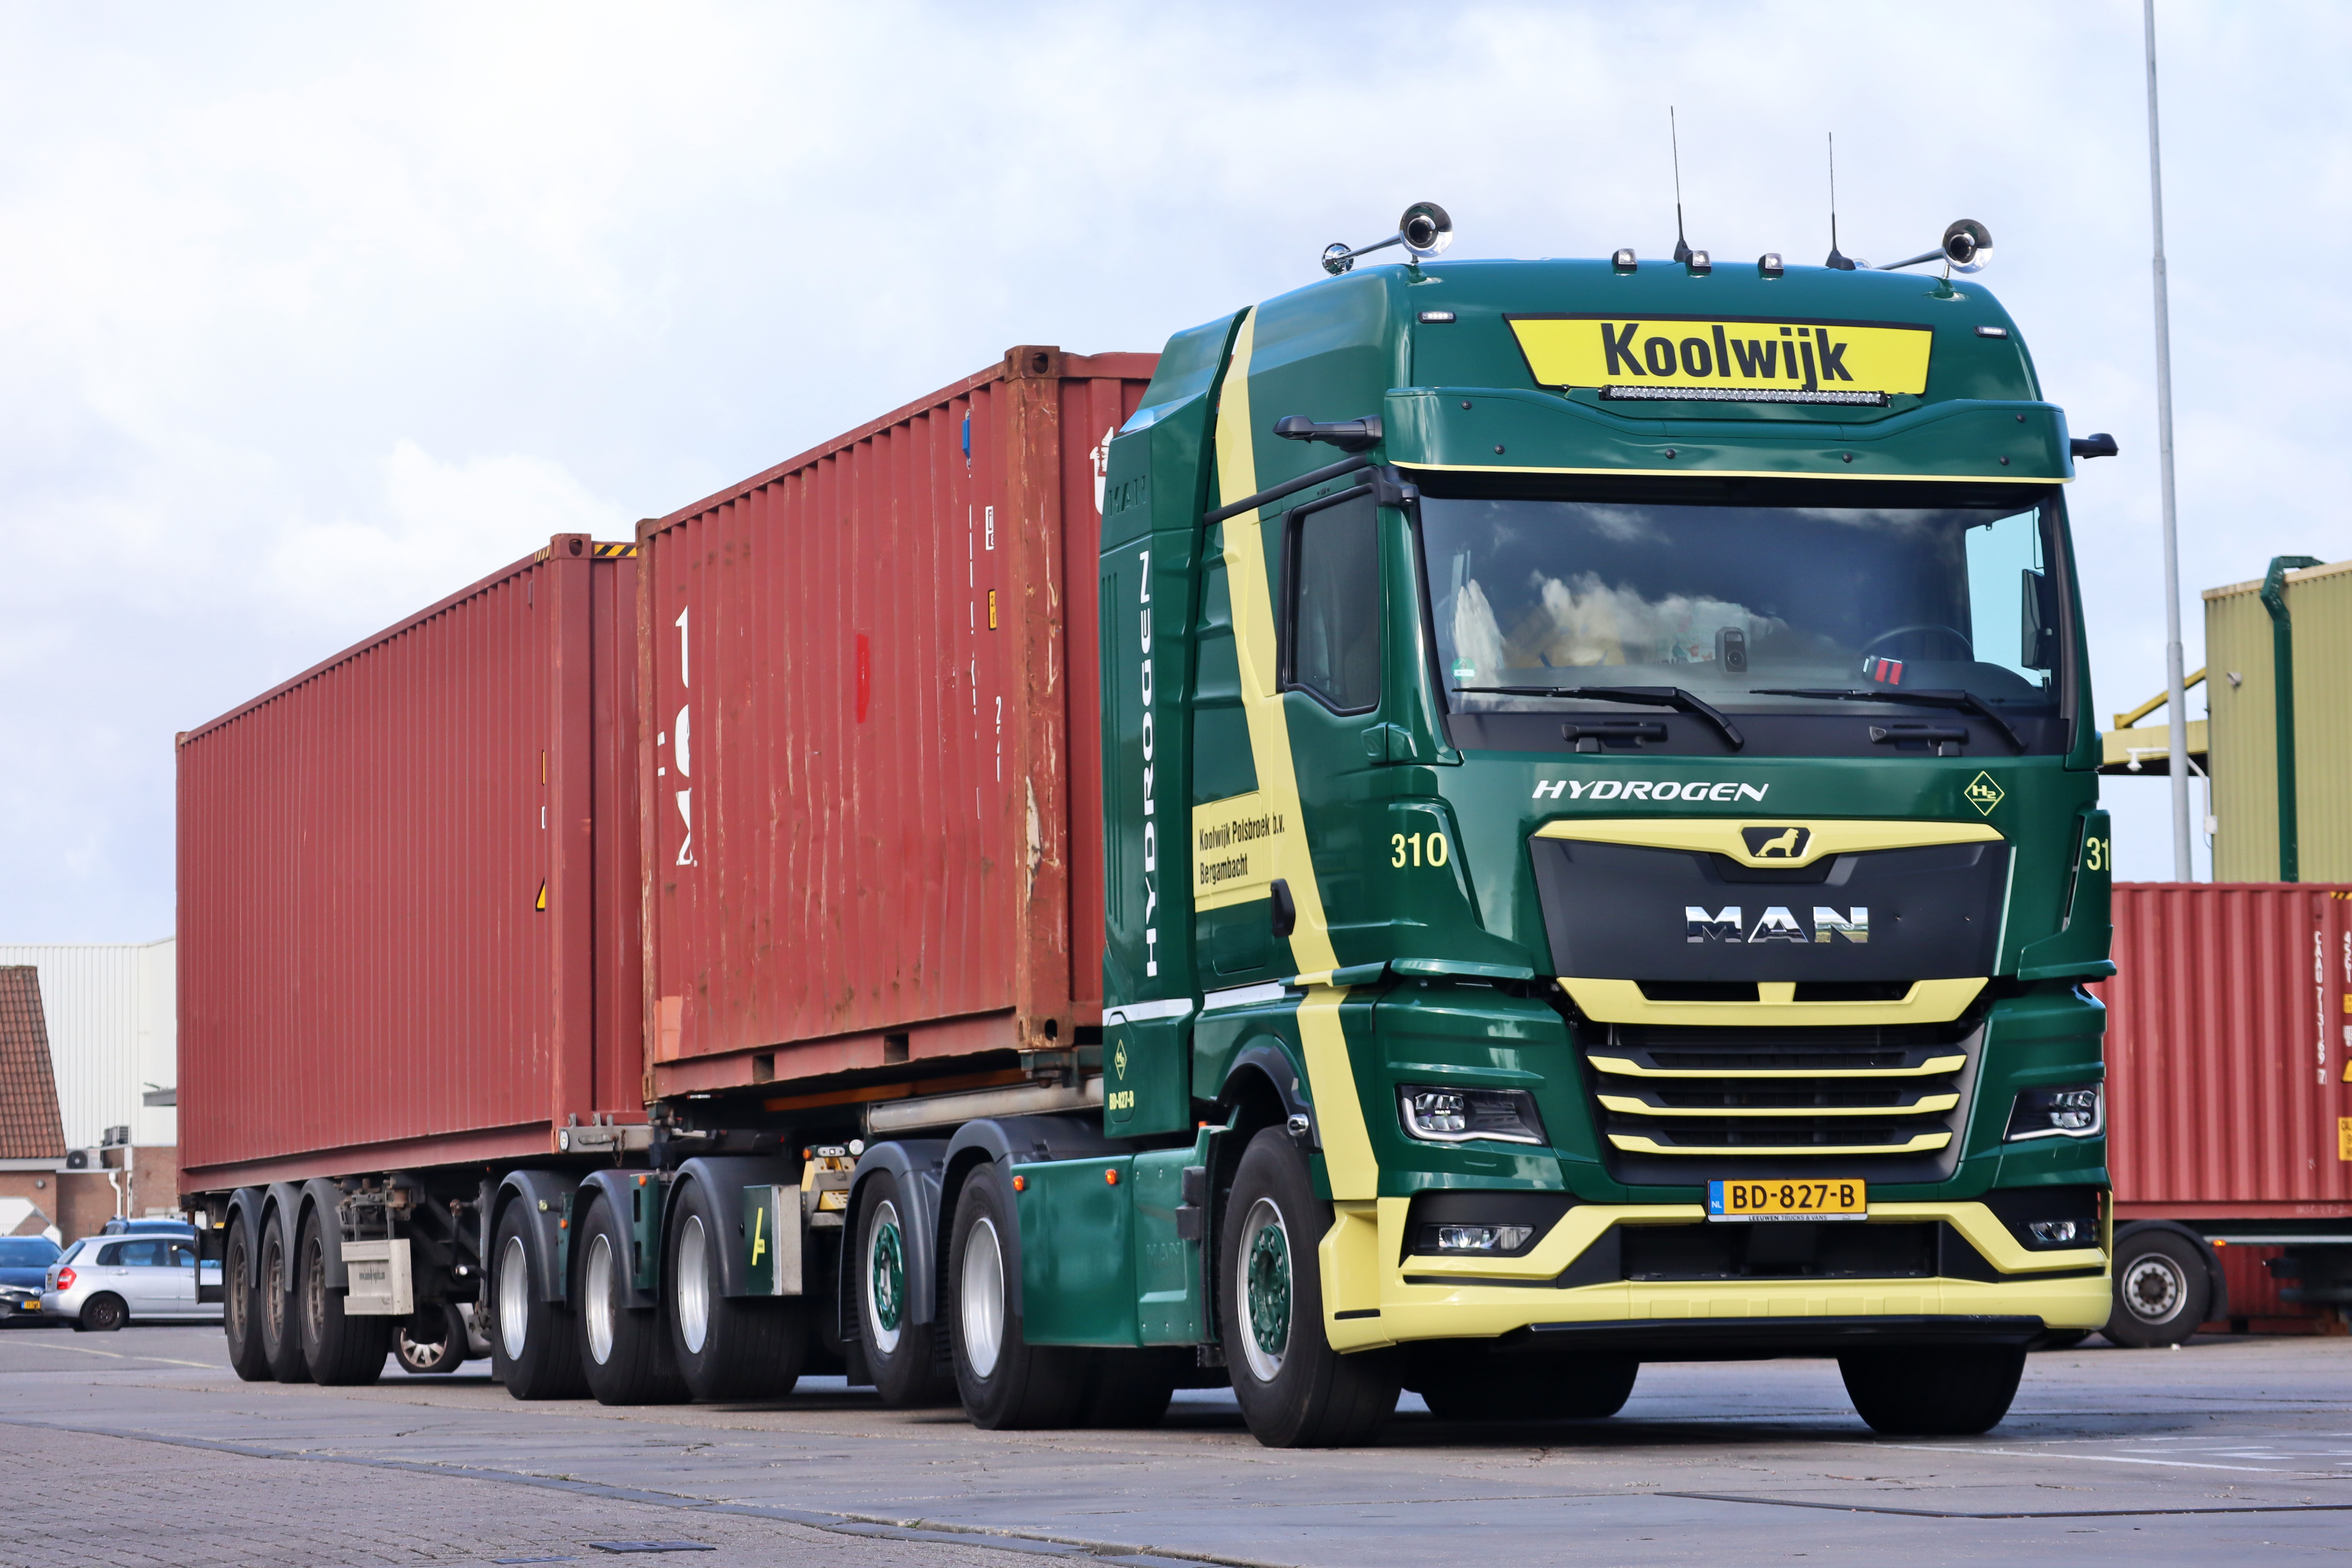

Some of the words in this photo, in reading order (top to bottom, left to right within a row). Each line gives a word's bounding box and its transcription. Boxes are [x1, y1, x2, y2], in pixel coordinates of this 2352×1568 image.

[1601, 323, 1854, 391] Koolwijk
[1108, 475, 1146, 517] MAN
[1139, 550, 1158, 977] HYDROGEN
[1532, 780, 1769, 801] HYDROGEN
[1200, 822, 1230, 851] Koolwijk
[1232, 813, 1270, 844] Polsbroek
[1273, 811, 1285, 835] b.v.
[1392, 832, 1448, 868] 310
[1200, 853, 1248, 885] Bergambacht
[1685, 906, 1868, 943] MAN
[2314, 930, 2323, 984] CAAU
[2316, 986, 2326, 1065] 713169
[1109, 1090, 1134, 1111] BD-827-B
[1711, 1200, 1722, 1209] NL
[1733, 1184, 1855, 1209] BD-827-B
